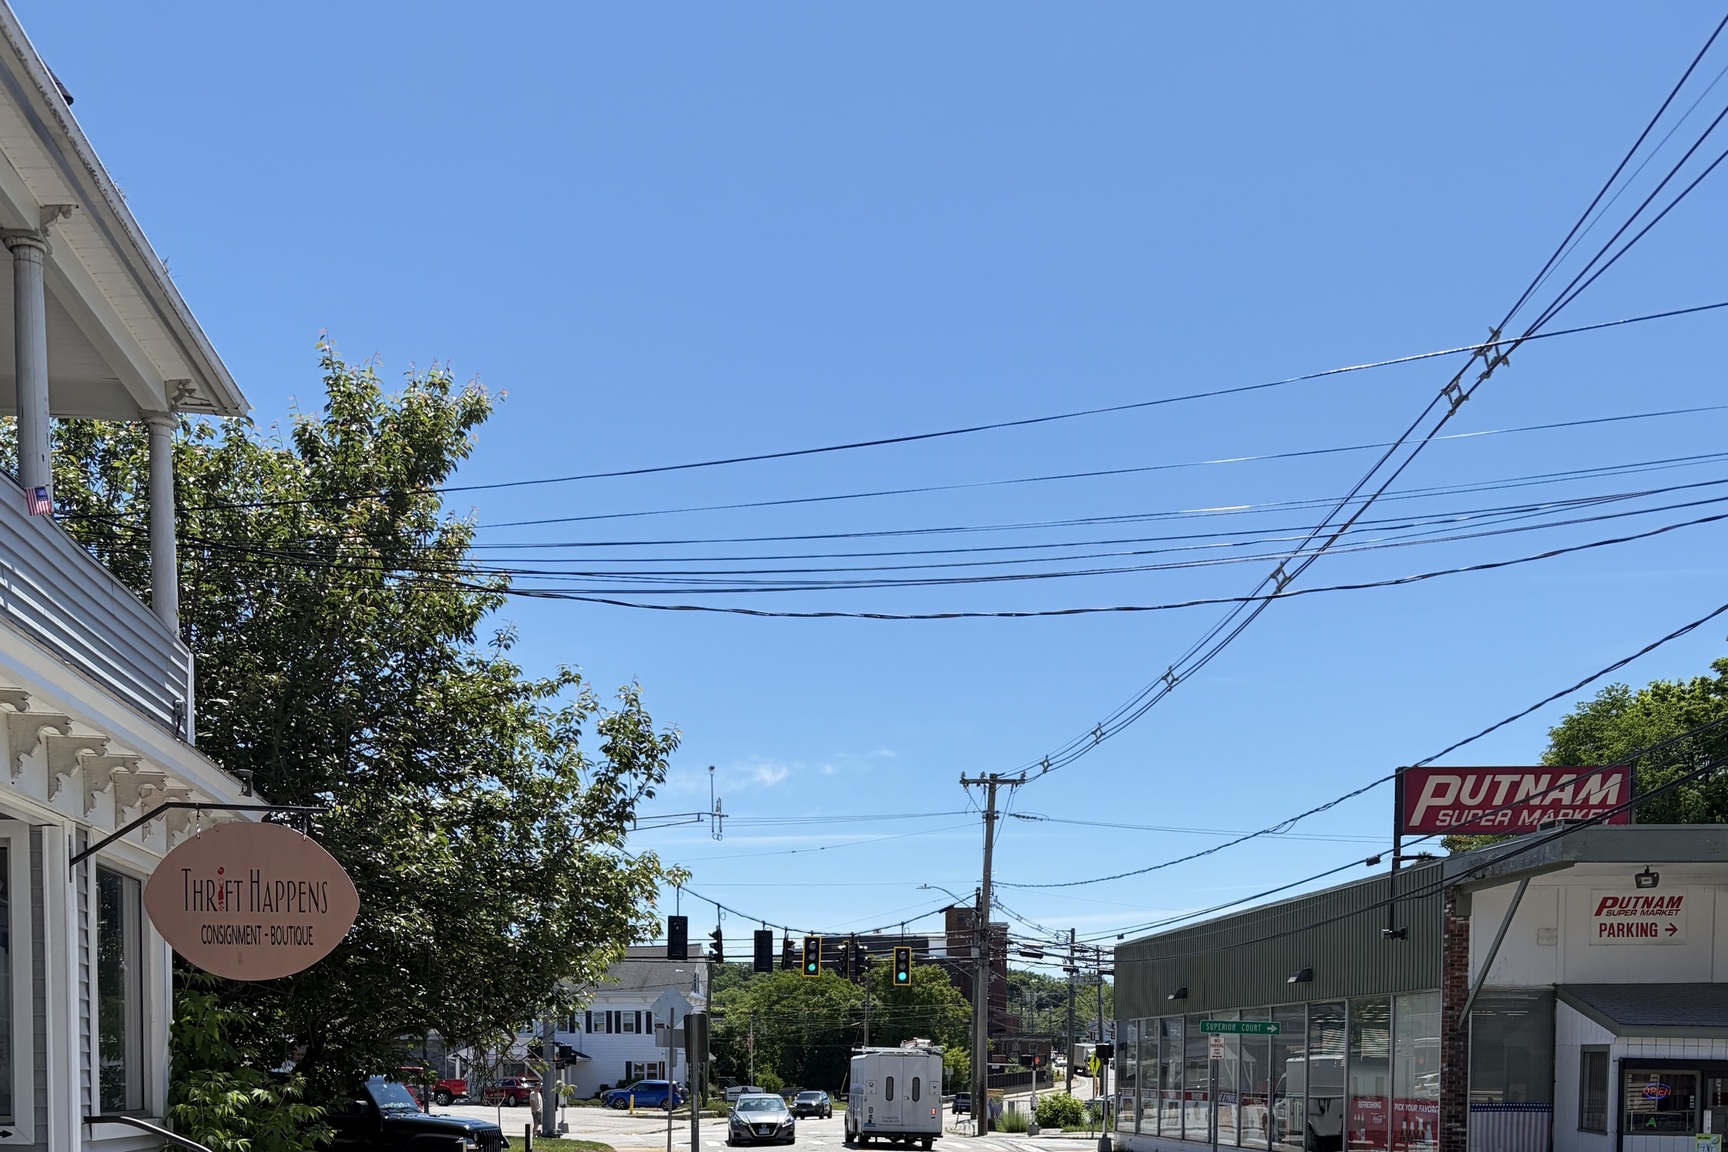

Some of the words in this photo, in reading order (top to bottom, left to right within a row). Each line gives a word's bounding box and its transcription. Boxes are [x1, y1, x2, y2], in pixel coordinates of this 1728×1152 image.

[1409, 774, 1623, 826] PUTNAM
[1435, 809, 1513, 826] SUPER
[250, 869, 328, 914] HAPPENS
[1594, 896, 1684, 917] PUTNAM
[1605, 909, 1638, 917] SUPER
[201, 924, 261, 946] CONSIGNMENT
[270, 925, 313, 946] BOUTIQUE
[1599, 922, 1658, 938] PARKING
[1205, 1022, 1236, 1031] SUPERIOR
[1241, 1023, 1261, 1032] COURT
[1642, 1087, 1671, 1096] OPEN
[1394, 1103, 1404, 1111] PICK
[1405, 1104, 1418, 1112] YOUR
